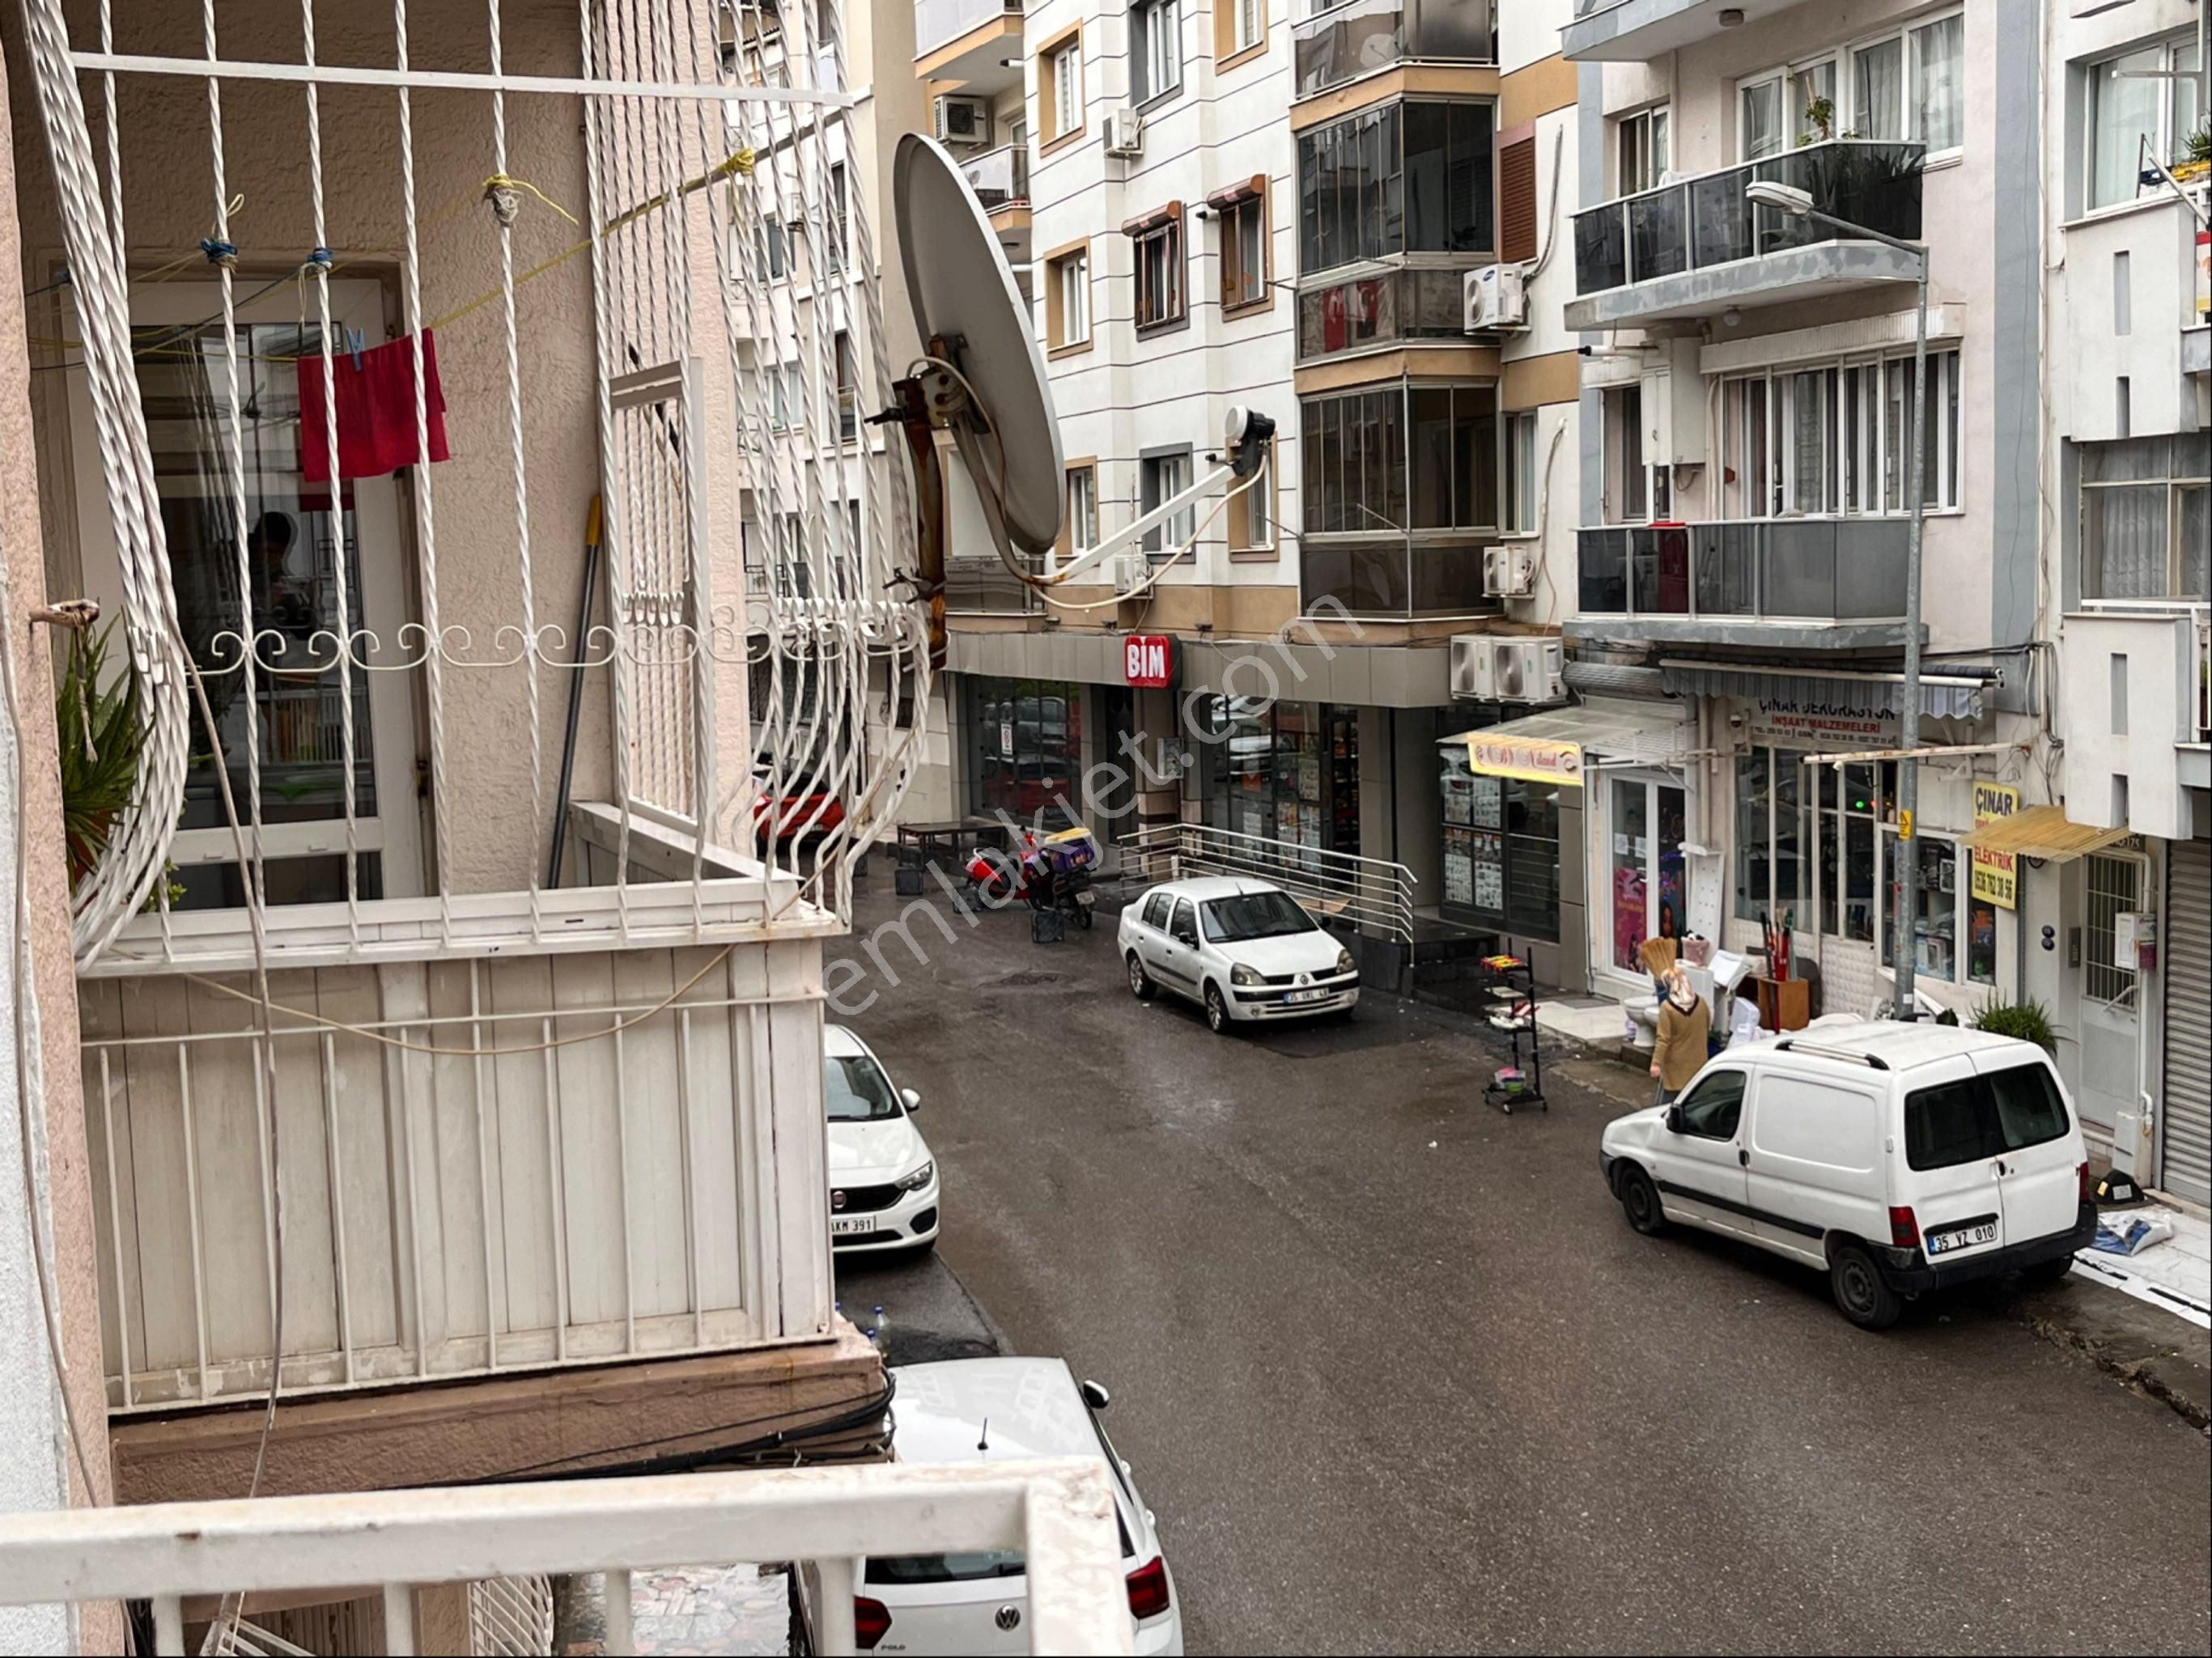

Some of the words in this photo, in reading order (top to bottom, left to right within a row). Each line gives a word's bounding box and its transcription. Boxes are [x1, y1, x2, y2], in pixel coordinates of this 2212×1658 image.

[1127, 636, 1165, 678] BİM
[1771, 715, 1807, 727] İNŞAAT
[1808, 718, 1881, 734] MALZEMELERİ
[1976, 787, 2013, 816] ÇINAR
[1974, 846, 2015, 873] ELEKTRİK
[852, 1219, 871, 1232] 391
[1935, 1236, 1949, 1251] 35
[1975, 1225, 1994, 1240] 010
